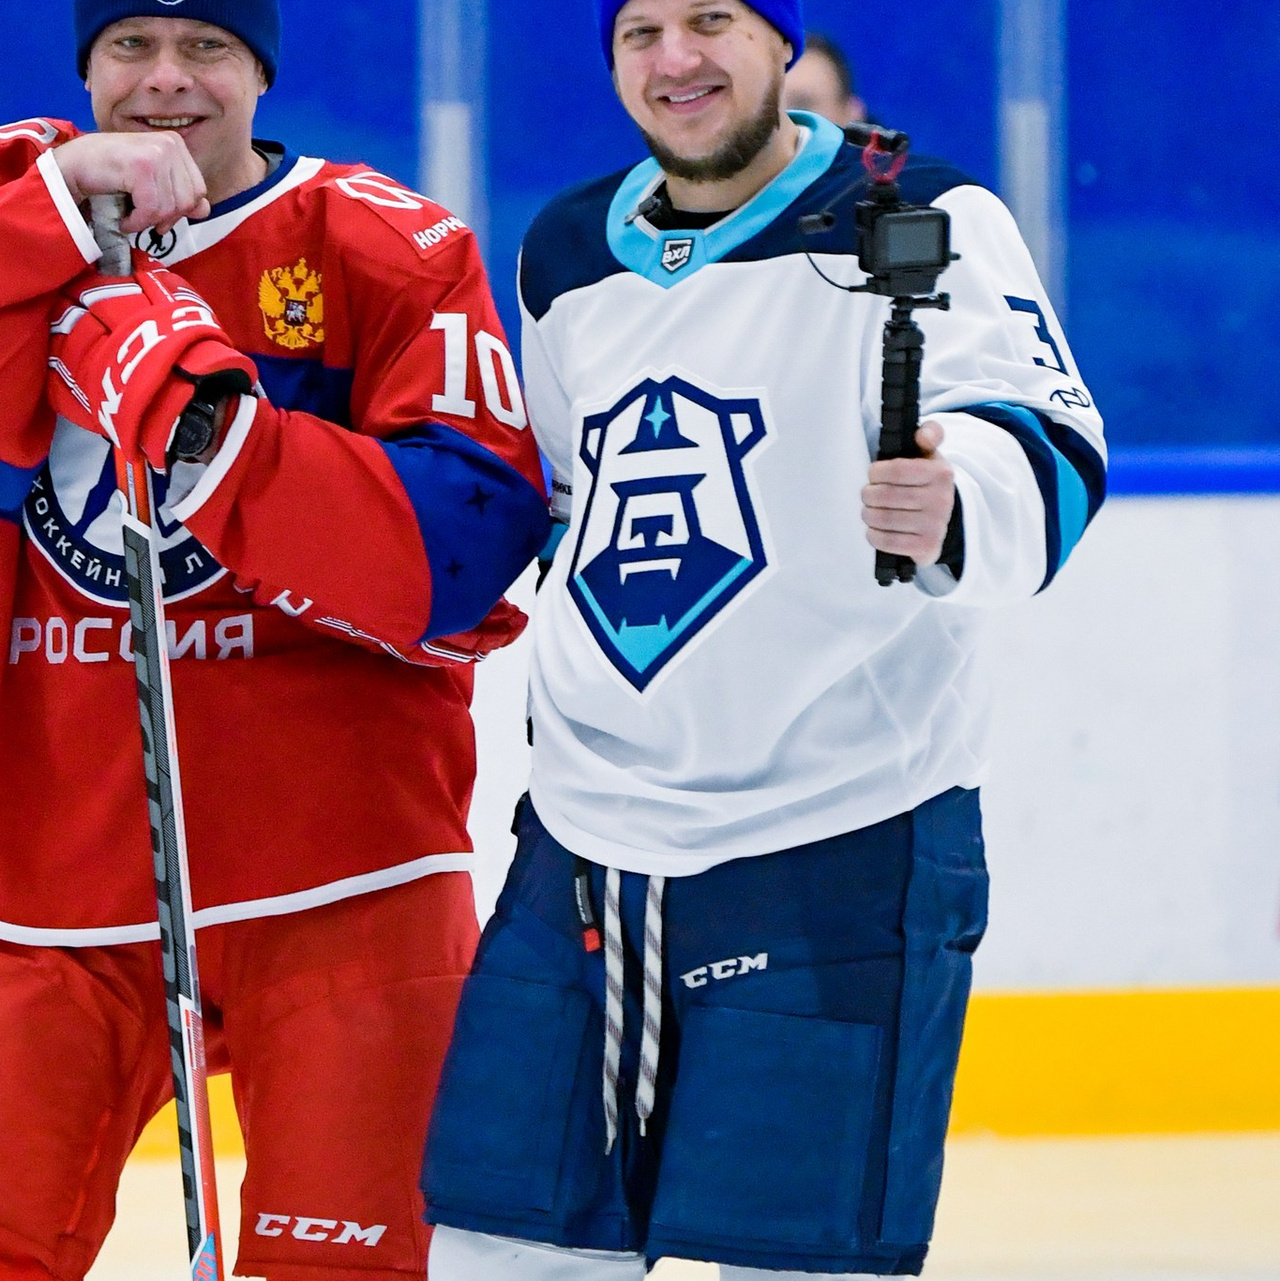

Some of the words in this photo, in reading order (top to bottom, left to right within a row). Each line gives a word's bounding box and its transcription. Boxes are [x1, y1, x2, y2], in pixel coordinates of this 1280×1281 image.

[429, 310, 528, 431] 10
[679, 952, 769, 989] CCM
[254, 1212, 388, 1248] CCM
